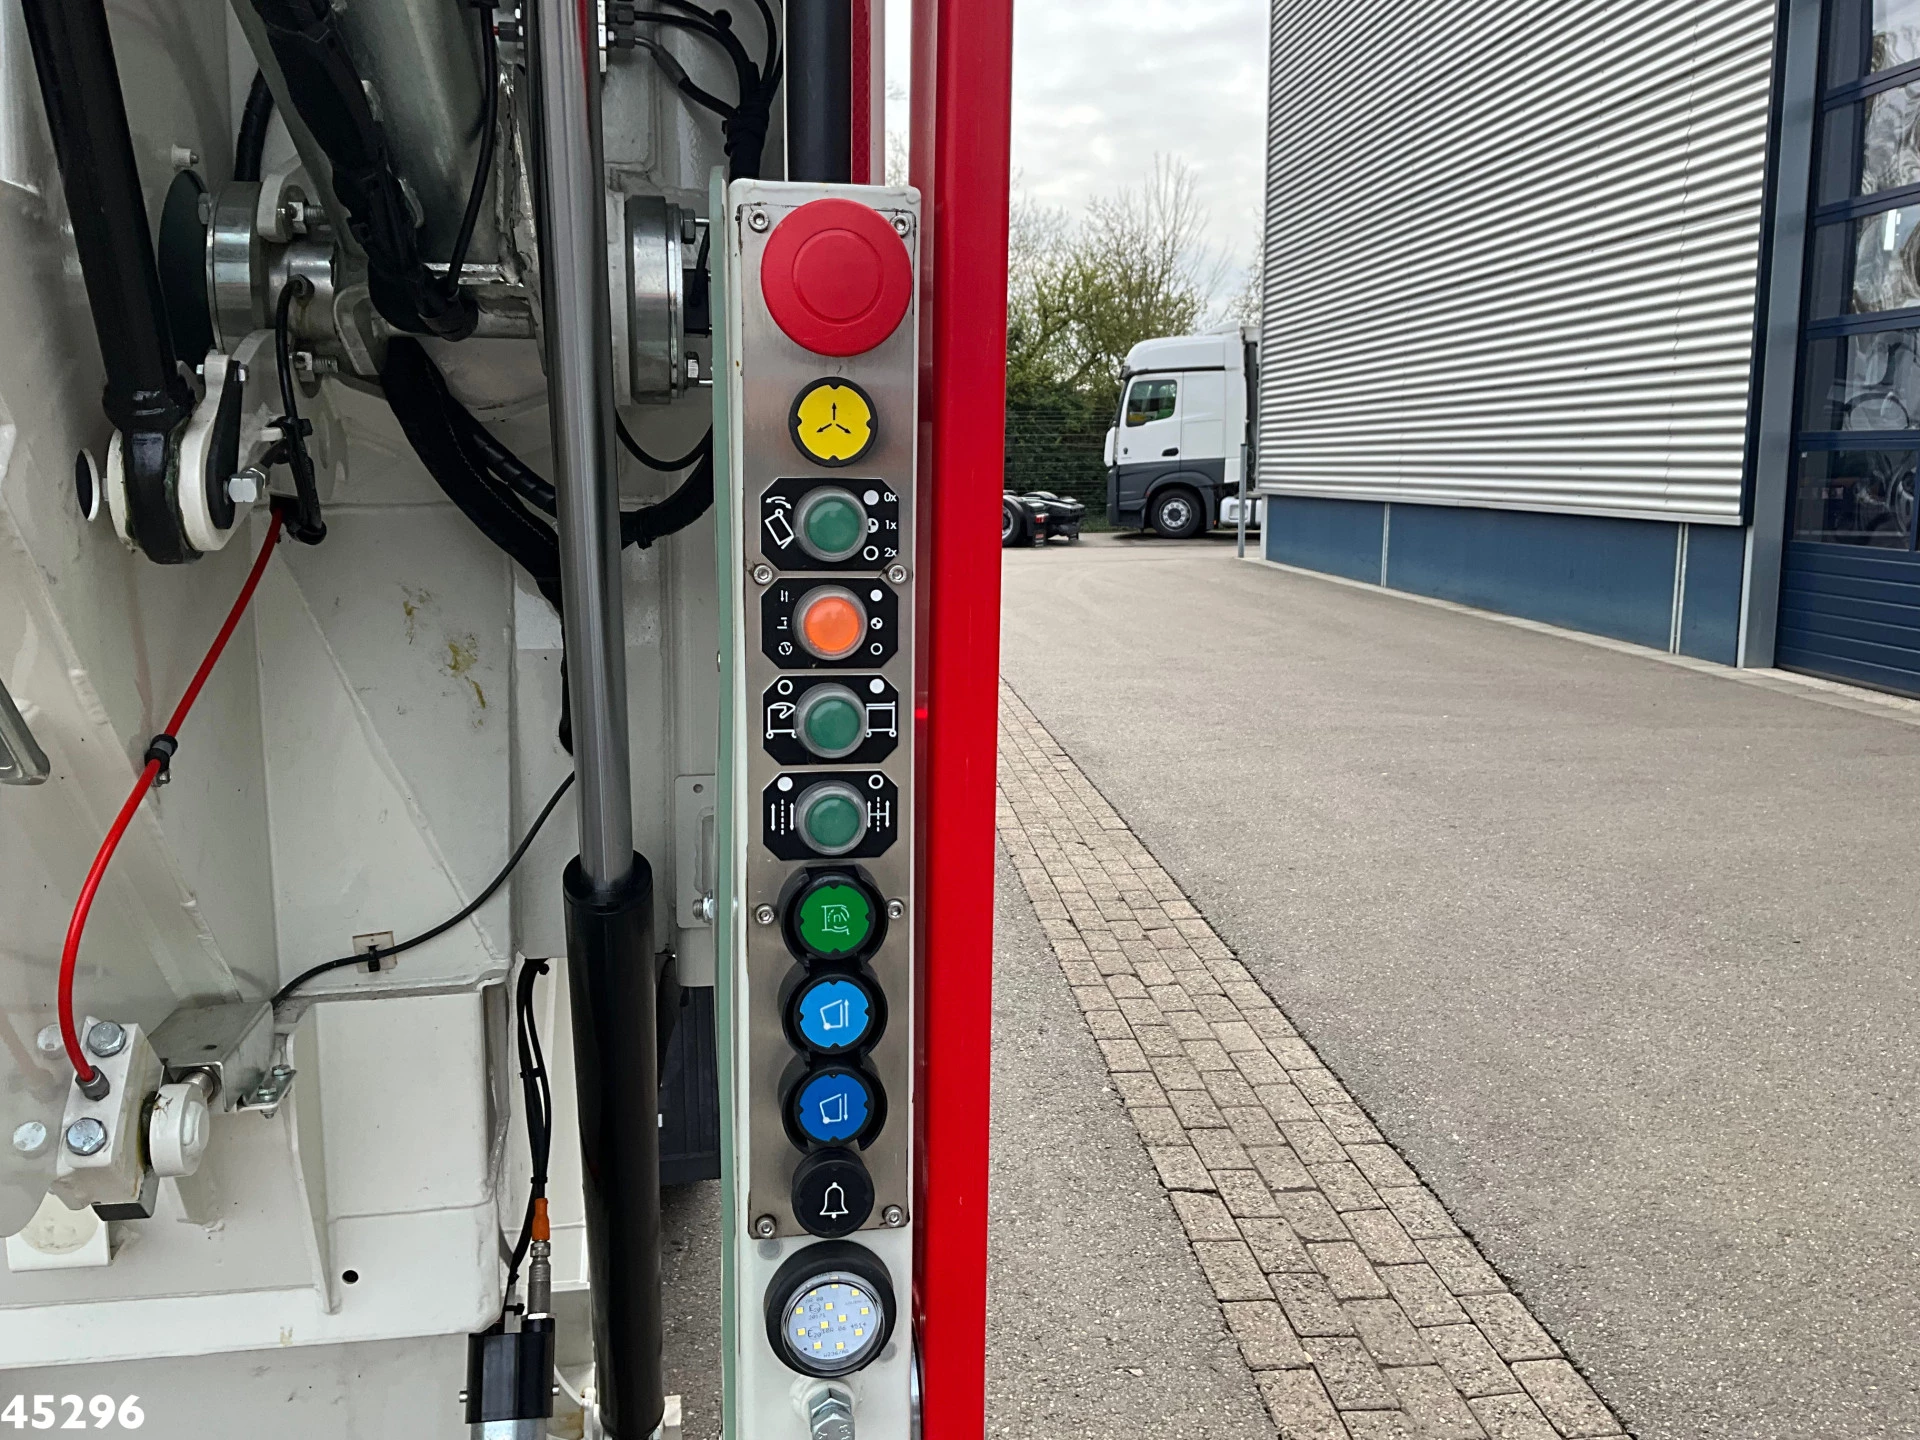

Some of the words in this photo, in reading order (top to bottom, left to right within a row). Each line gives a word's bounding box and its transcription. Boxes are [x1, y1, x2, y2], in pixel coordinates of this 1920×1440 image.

[884, 492, 897, 502] 0x
[885, 519, 897, 530] 1x
[884, 547, 897, 558] 2x
